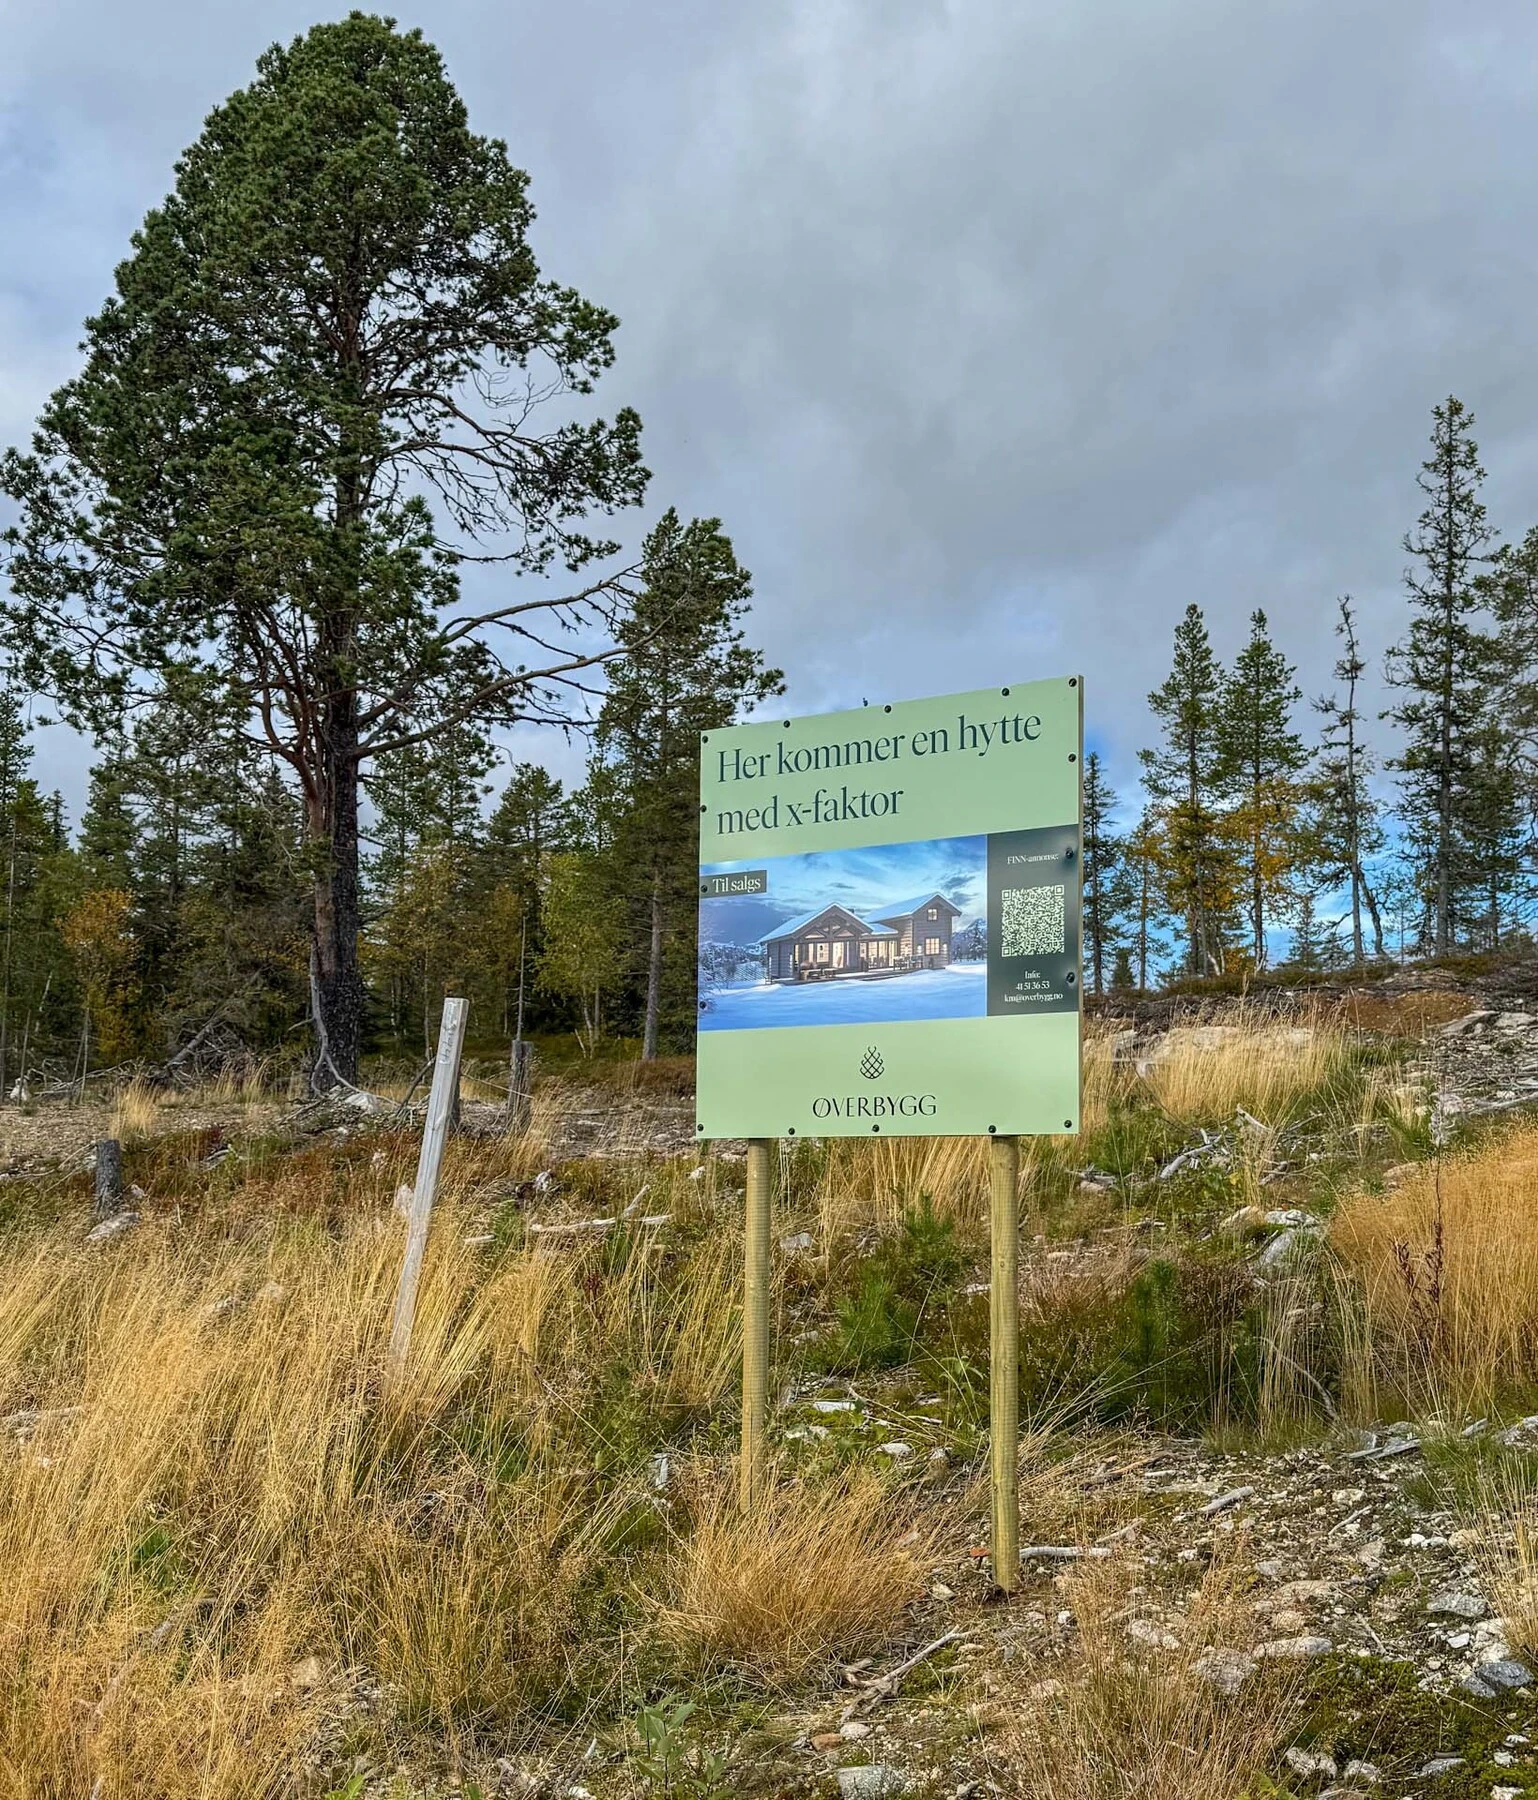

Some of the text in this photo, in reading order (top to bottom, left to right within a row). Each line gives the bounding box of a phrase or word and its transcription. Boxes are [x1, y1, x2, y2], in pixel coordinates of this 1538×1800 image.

[717, 713, 1042, 783] Her kommer en hytte
[716, 786, 904, 835] med x-faktor
[712, 876, 761, 893] Til salgs
[1025, 970, 1041, 979] Info:
[1015, 980, 1050, 991] 41 51 36 53
[812, 1094, 937, 1119] ØVERBYGG
